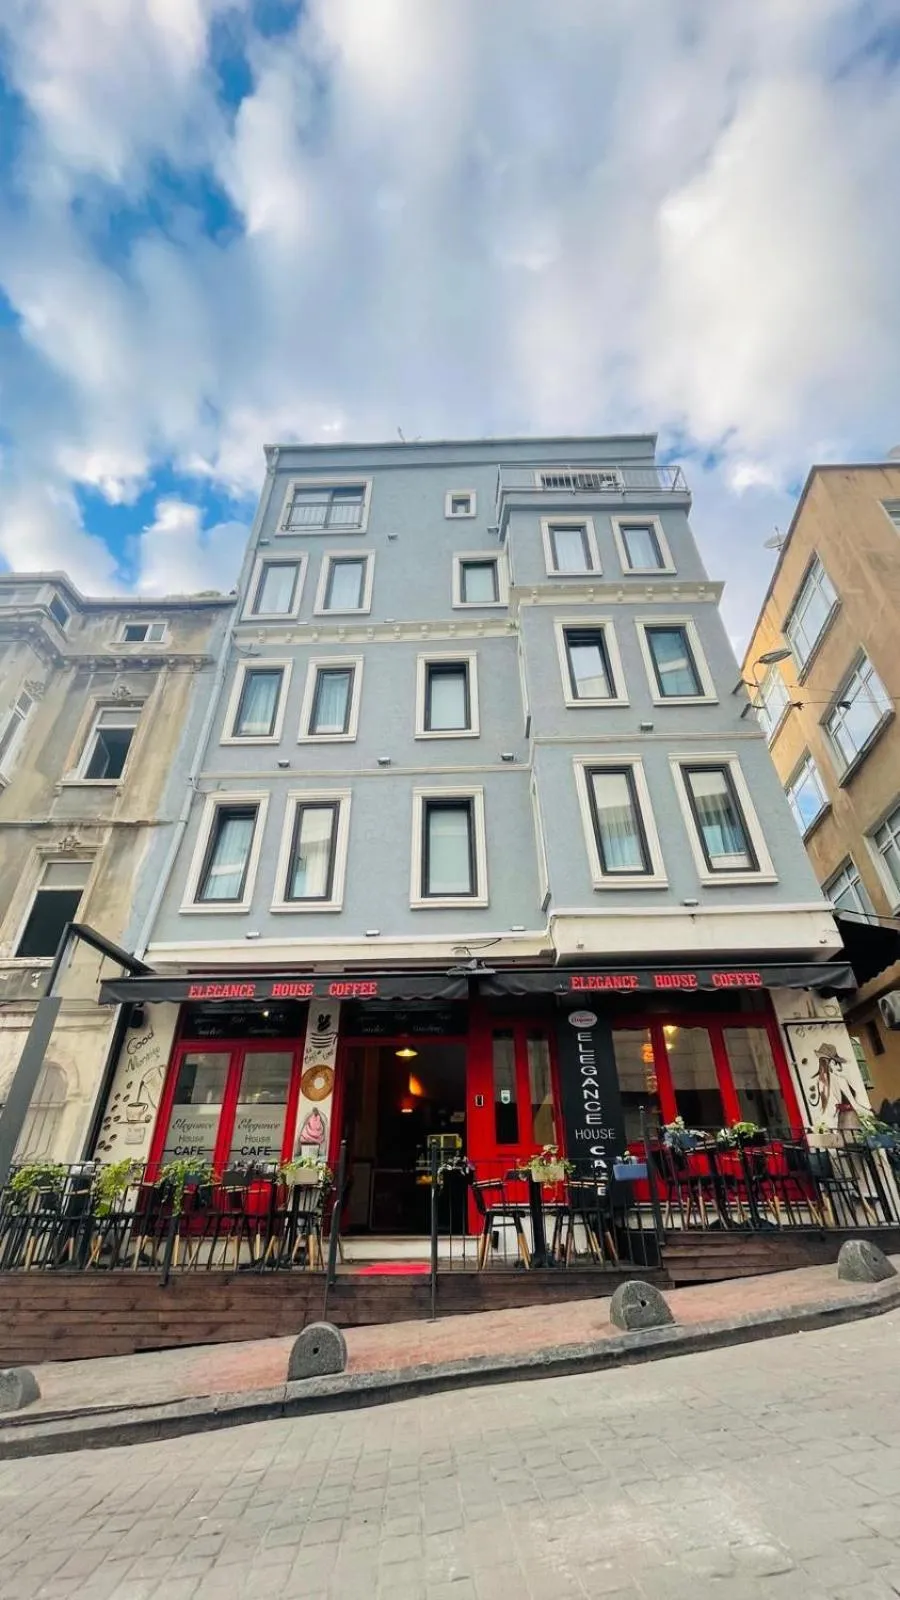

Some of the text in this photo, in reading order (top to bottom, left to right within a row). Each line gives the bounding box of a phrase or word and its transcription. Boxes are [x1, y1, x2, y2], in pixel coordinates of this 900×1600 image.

[571, 973, 763, 990] ELEGANCE HOUSE COFFEE
[188, 982, 378, 998] ELEGANCE HOUSE COFFEE
[127, 1024, 154, 1055] Good
[577, 1031, 603, 1125] ELEGANCE
[172, 1118, 214, 1133] Elegance
[238, 1118, 280, 1133] Elegance
[575, 1128, 616, 1140] HOUSE
[174, 1146, 205, 1155] CAFE
[240, 1146, 272, 1155] CAFE
